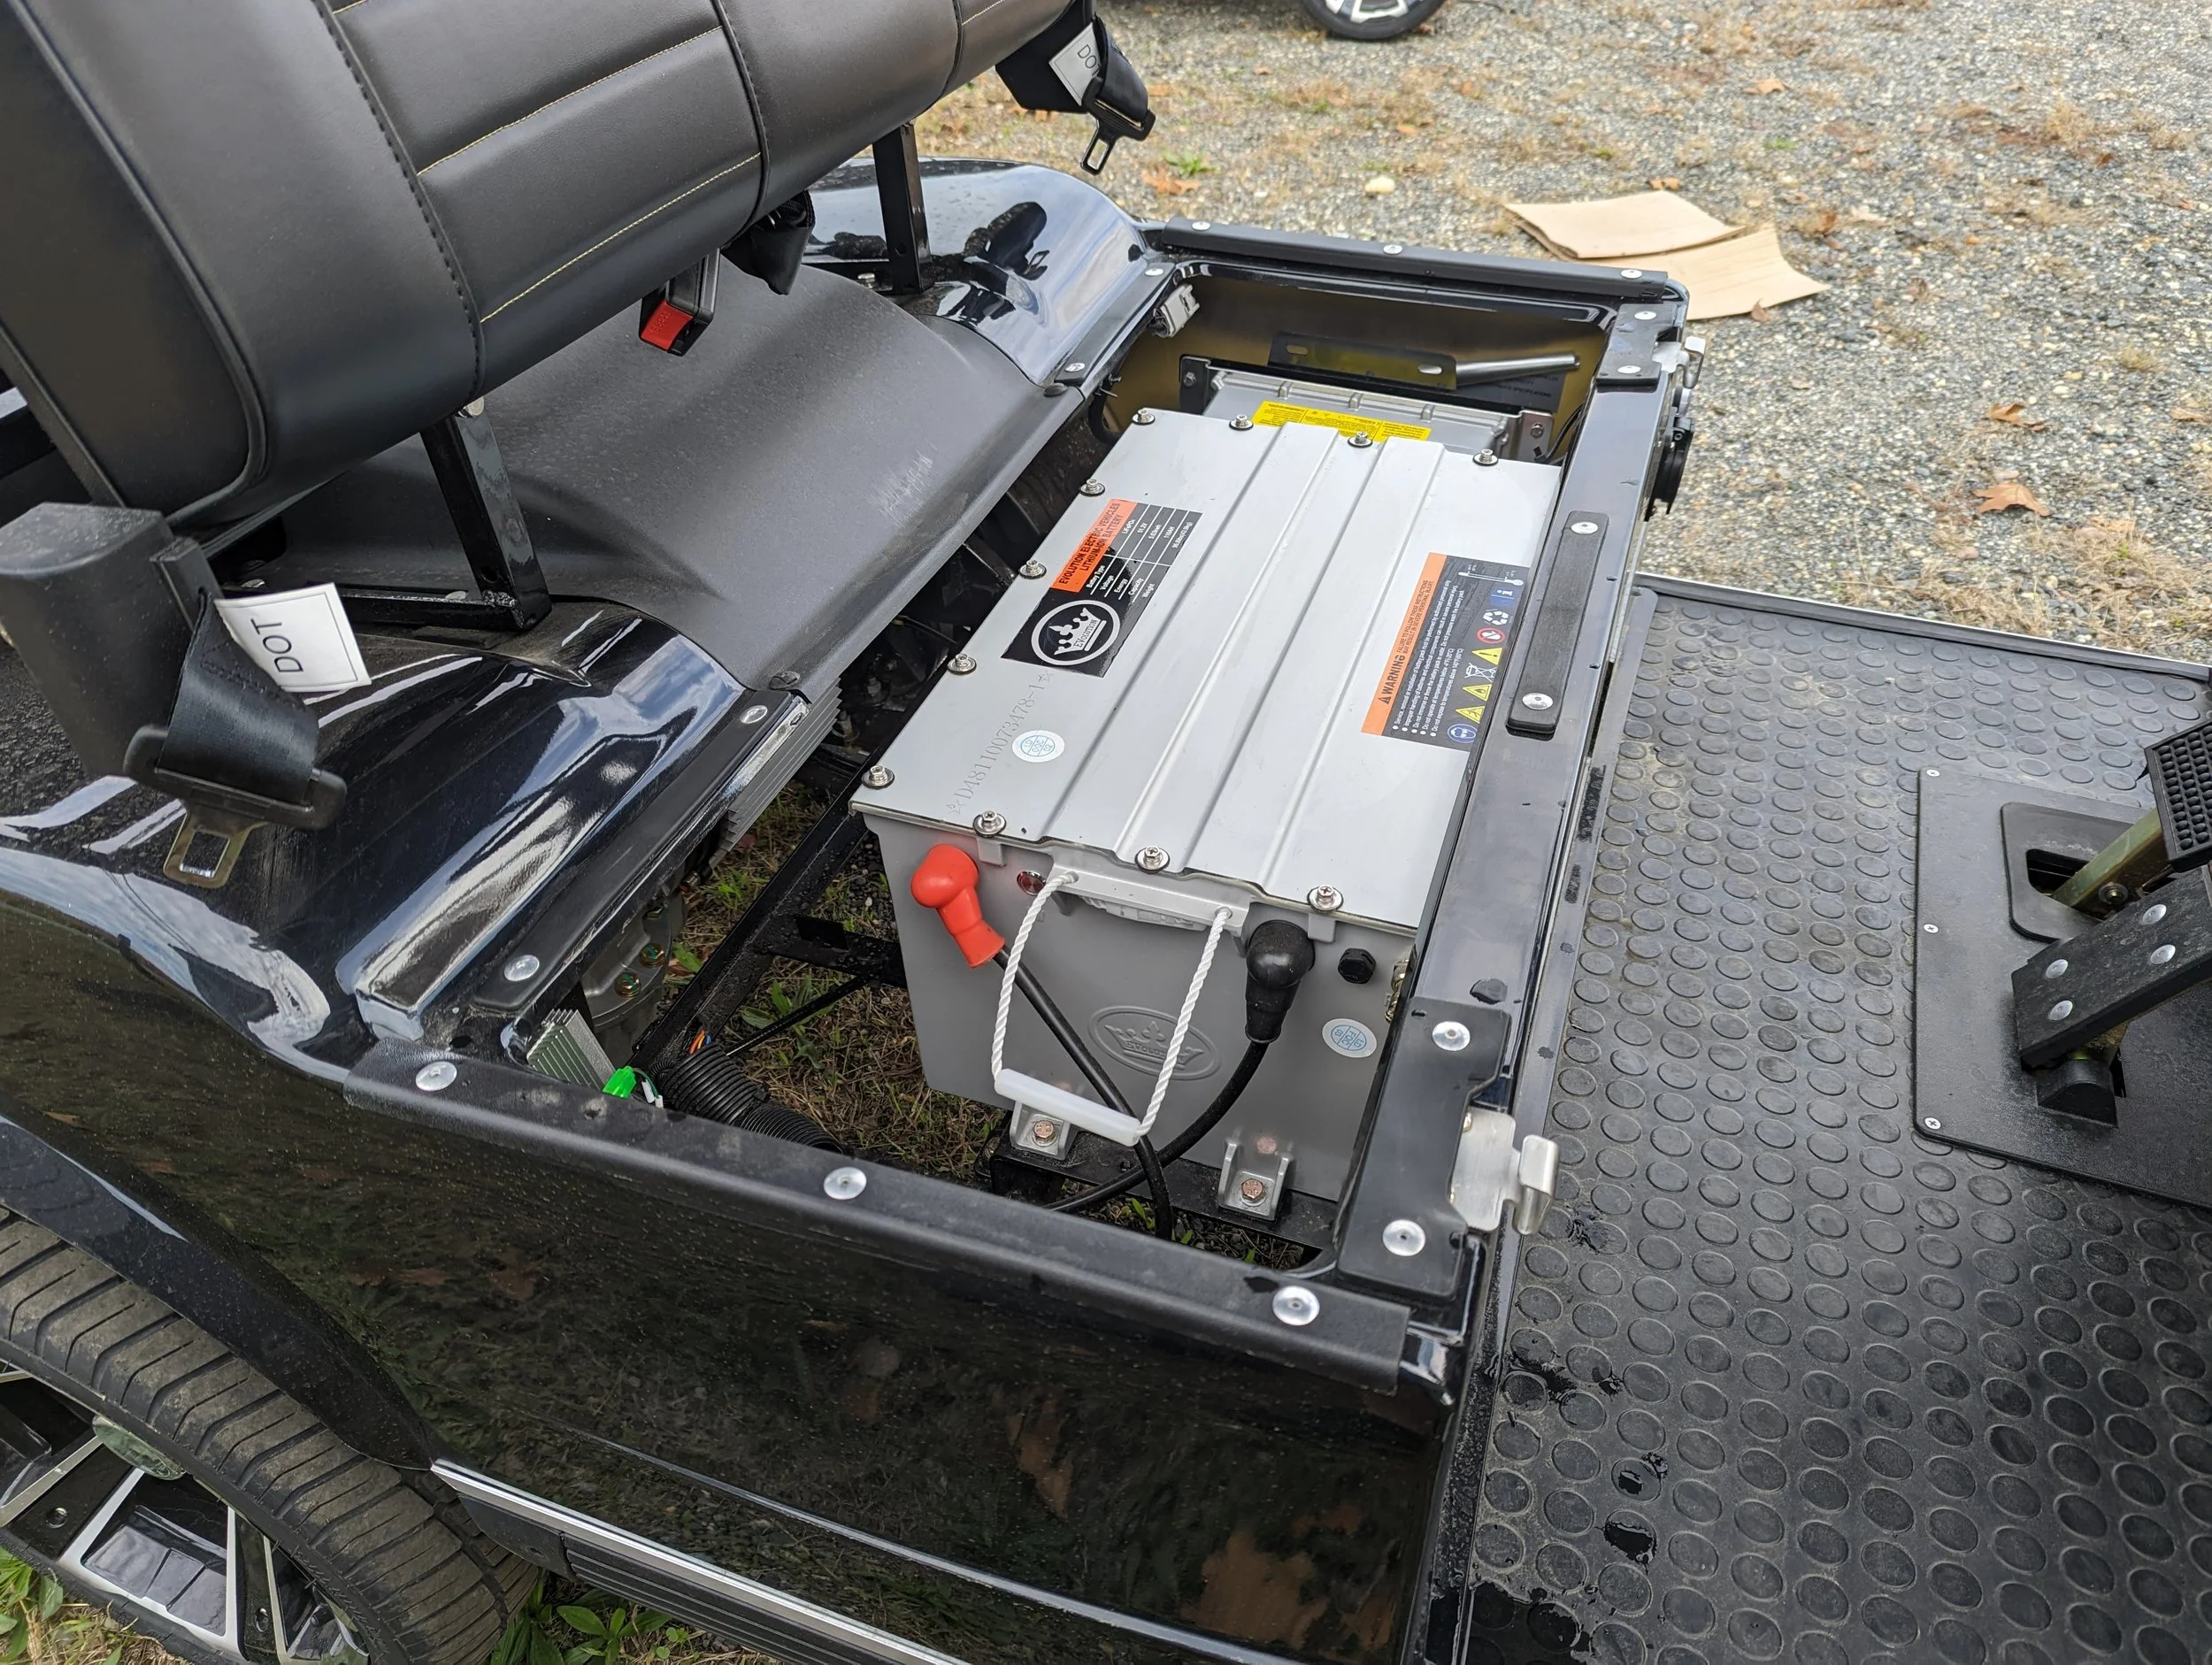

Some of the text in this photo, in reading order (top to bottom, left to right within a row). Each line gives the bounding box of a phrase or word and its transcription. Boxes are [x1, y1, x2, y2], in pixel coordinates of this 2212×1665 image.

[1137, 523, 1149, 533] 51.2V
[1059, 503, 1122, 584] EVOLUTION ELECTRIC VEHICLES
[1079, 514, 1125, 571] LITHIUM-ION BATTERY
[1094, 565, 1108, 575] Type
[1100, 575, 1116, 591] Voltage
[1114, 579, 1130, 593] Energy
[1128, 578, 1146, 596] Capacity
[1142, 584, 1157, 598] Weight
[1405, 617, 1415, 632] FOLLOW
[1411, 605, 1419, 617] THESE
[1415, 580, 1429, 605] INSTRUCTIONS
[1406, 631, 1416, 646] RESULT
[1413, 613, 1423, 627] SEVERE
[1419, 594, 1430, 612] PERSONAL
[250, 618, 304, 673] DOT
[1382, 654, 1406, 695] WARNING
[1032, 740, 1044, 752] OQC
[1334, 1029, 1344, 1037] 03
[1341, 1030, 1356, 1045] FQC
